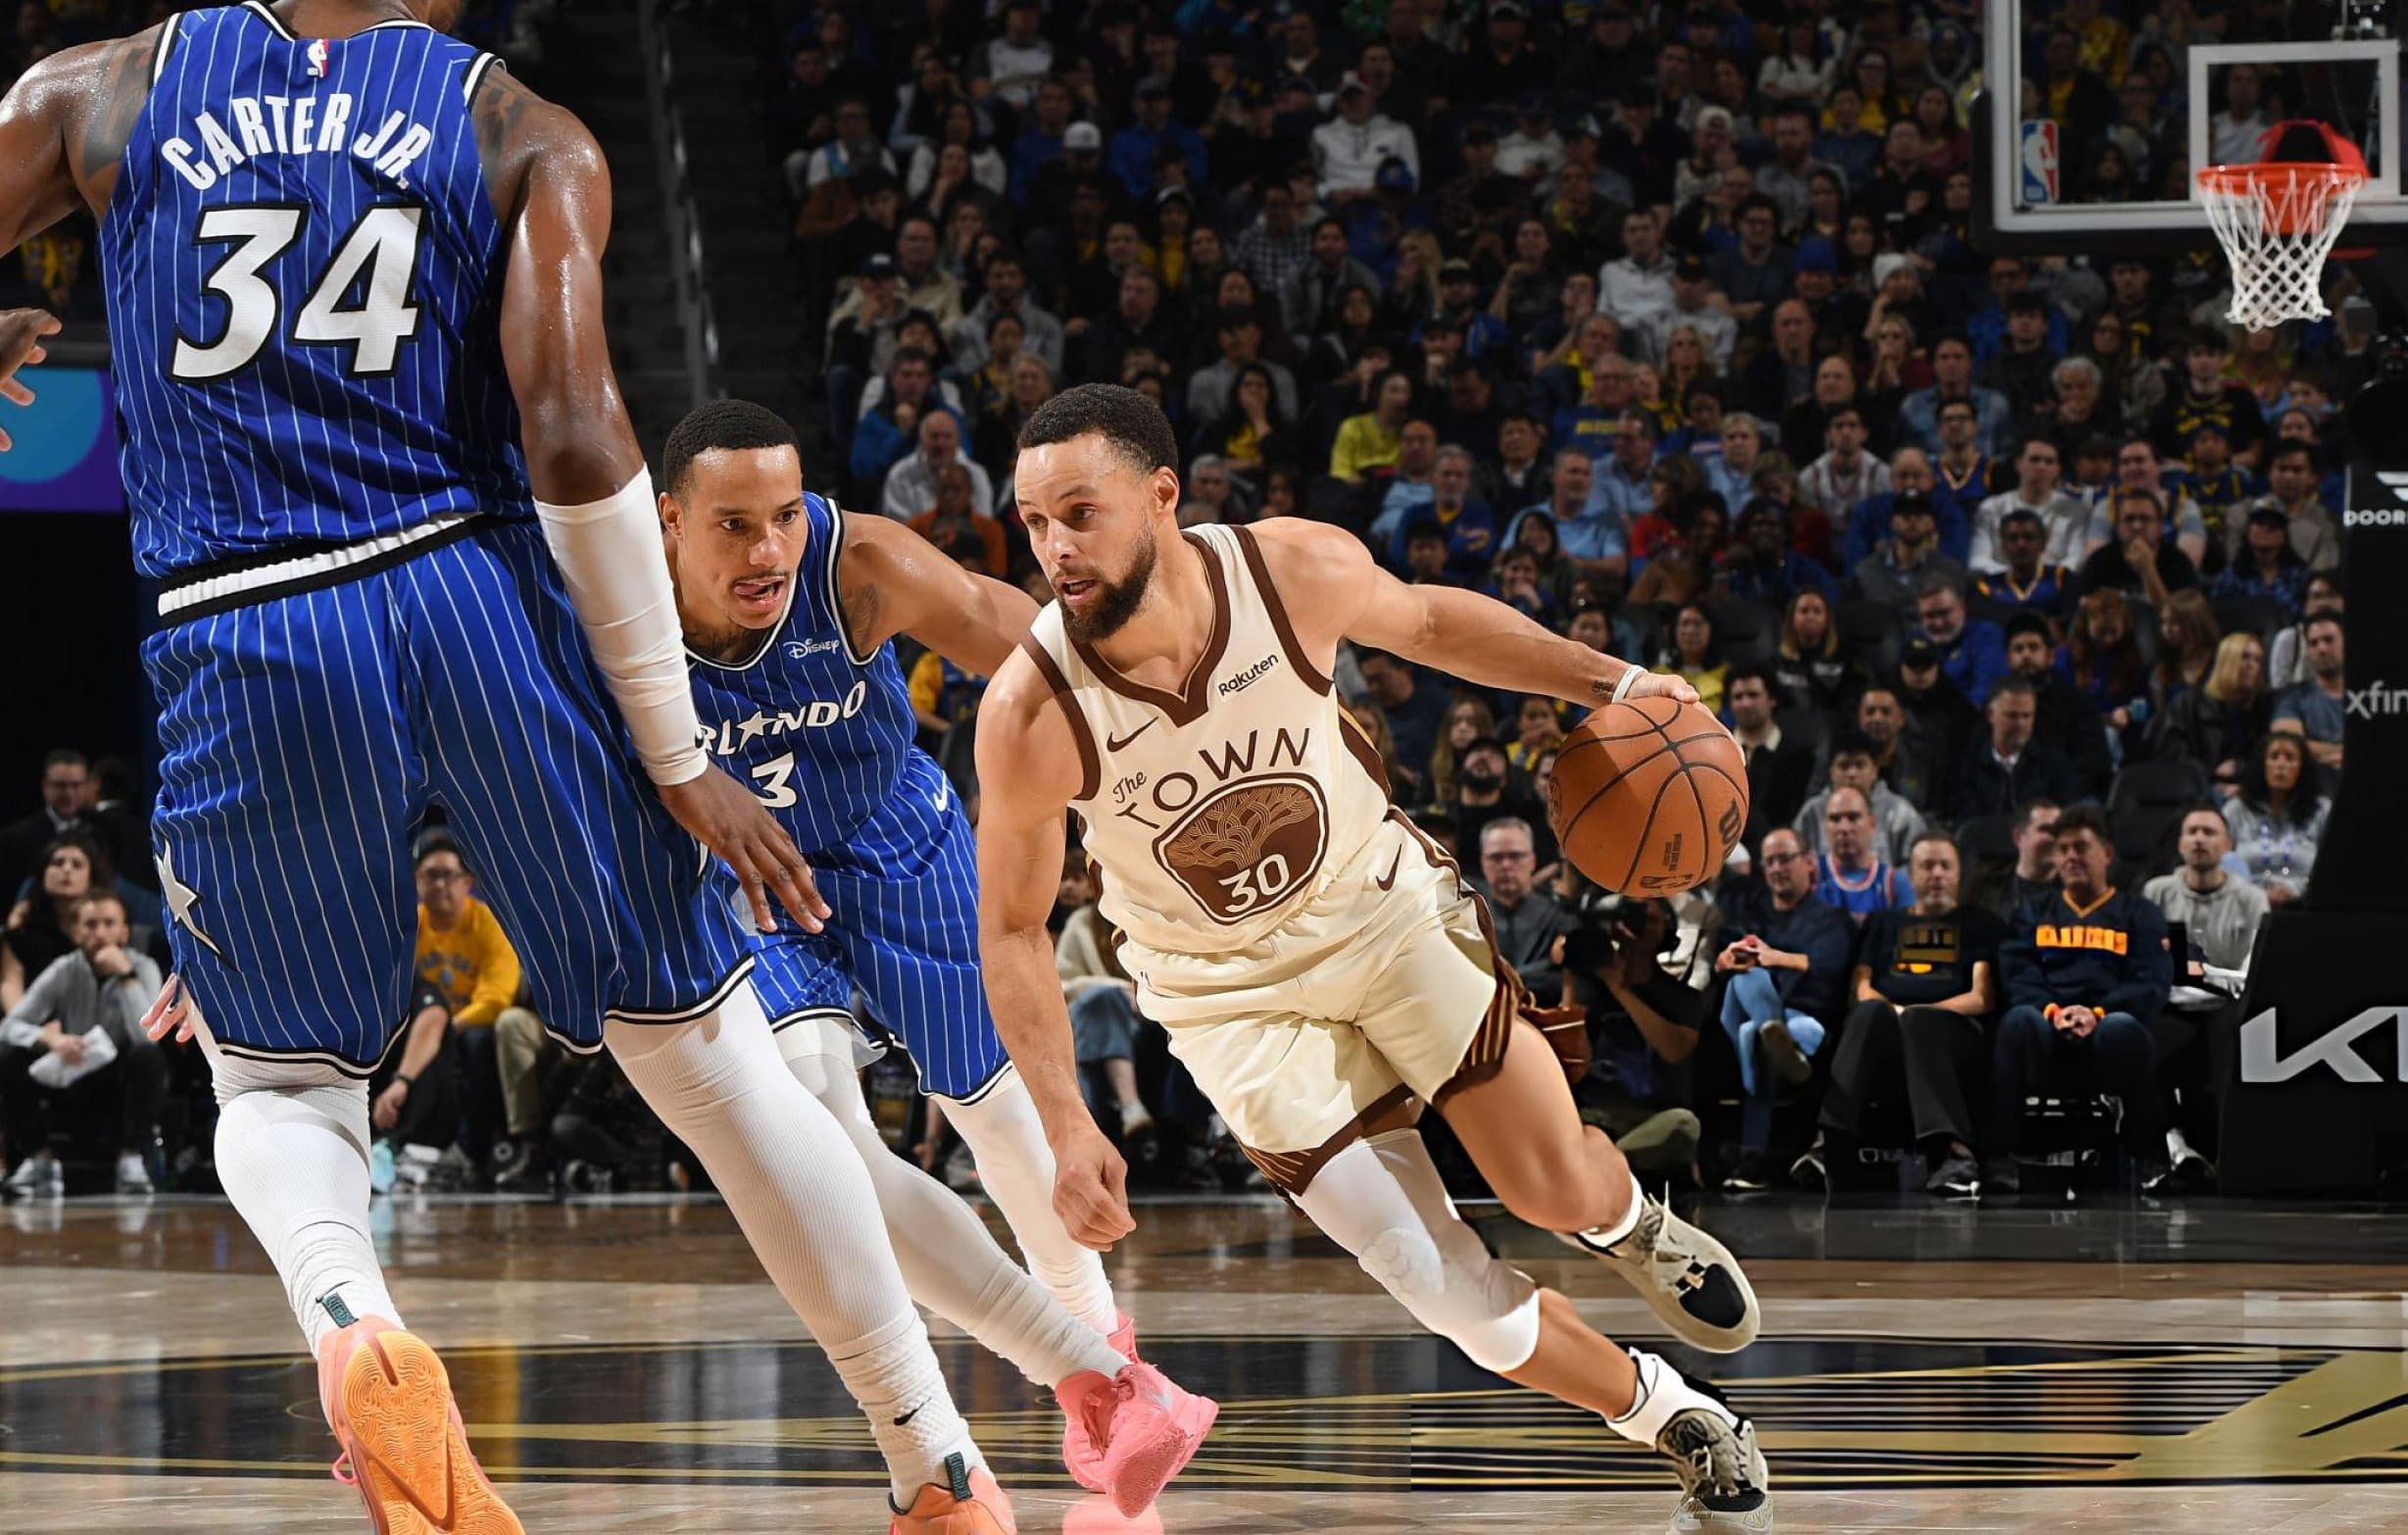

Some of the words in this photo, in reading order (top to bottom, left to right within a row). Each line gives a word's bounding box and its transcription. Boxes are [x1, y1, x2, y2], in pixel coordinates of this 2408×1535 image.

[162, 93, 352, 190] CARTER
[353, 110, 431, 189] JR.
[172, 206, 423, 378] 34
[2343, 509, 2408, 527] DOOR
[1218, 653, 1279, 697] Rakuten
[752, 752, 798, 808] 3
[1113, 770, 1148, 804] The
[1115, 727, 1310, 830] TOWN
[1218, 854, 1291, 913] 30
